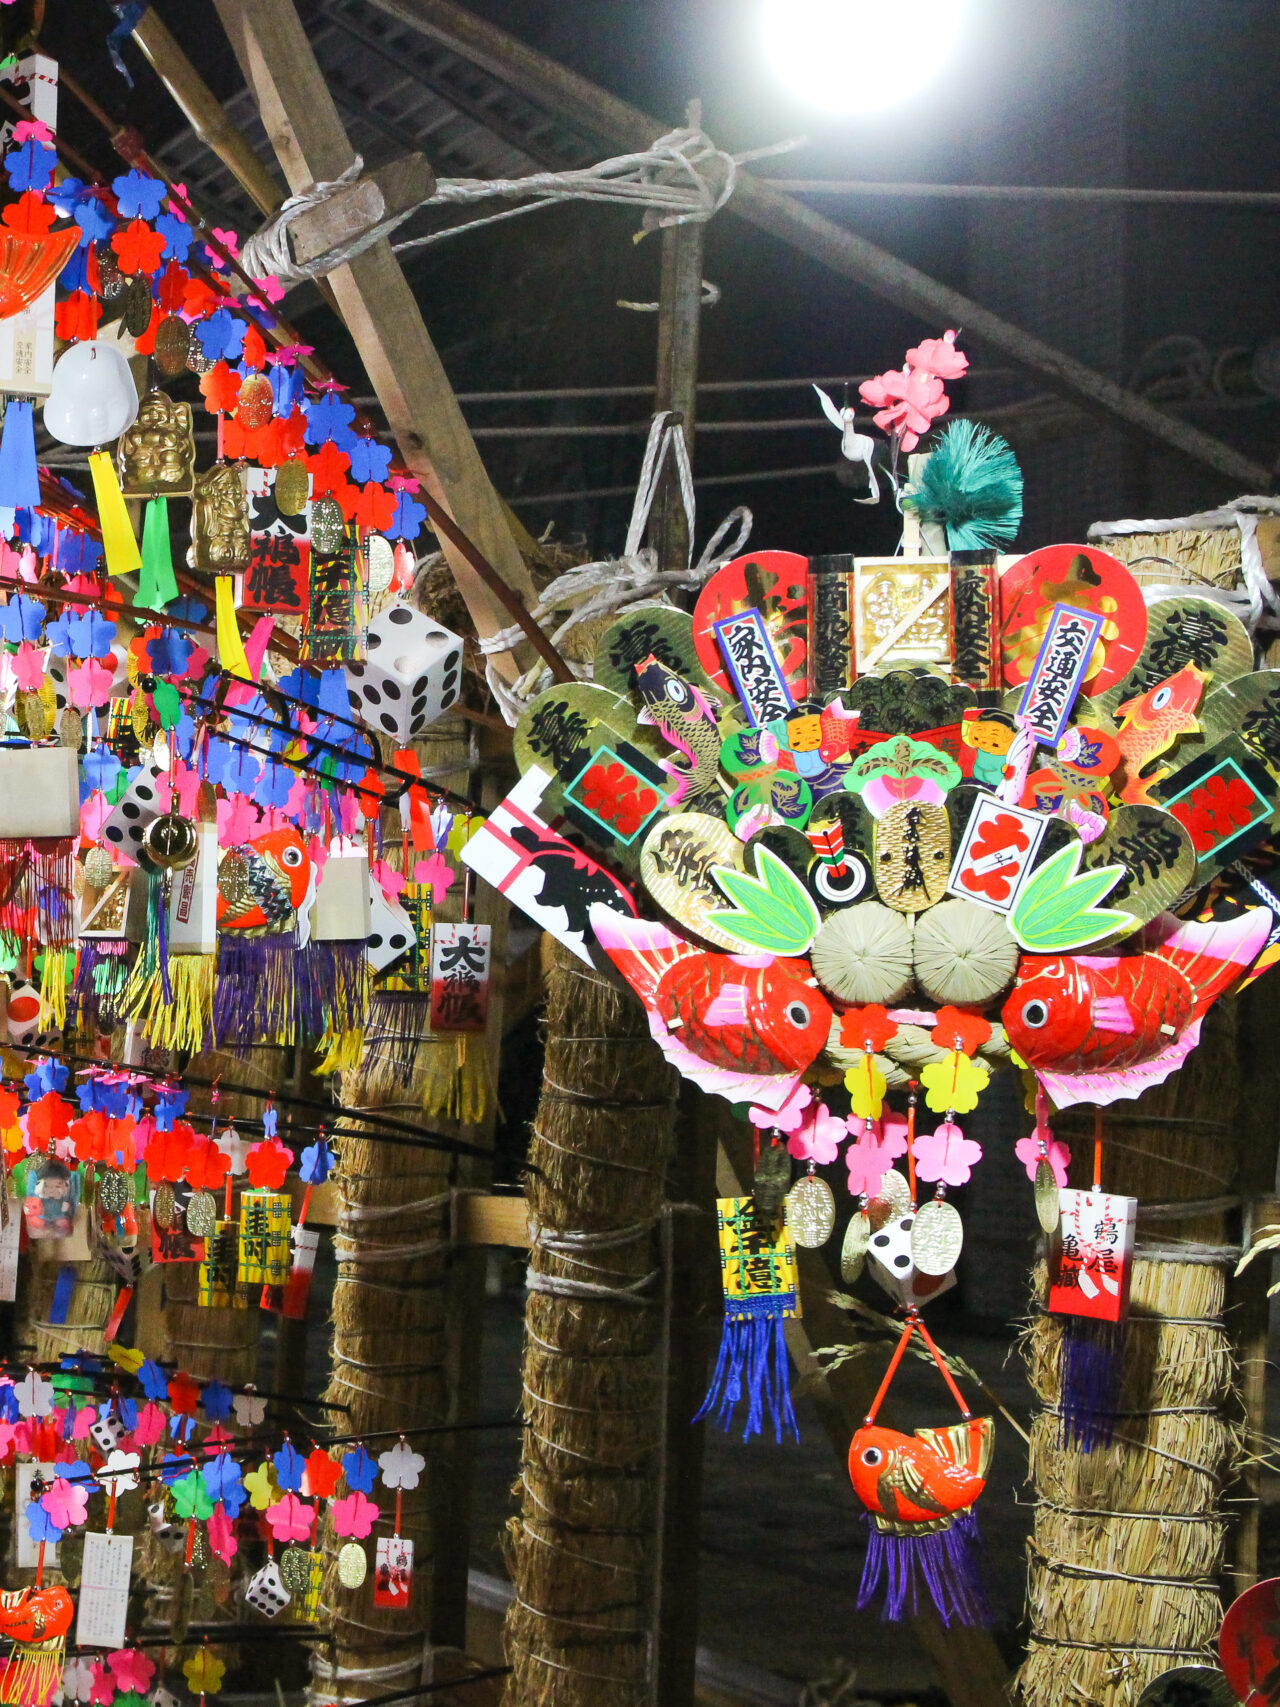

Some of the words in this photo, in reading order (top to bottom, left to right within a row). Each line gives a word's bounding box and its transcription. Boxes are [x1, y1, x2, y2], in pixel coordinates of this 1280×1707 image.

[726, 624, 788, 727] 家内安全
[953, 569, 992, 680] 家内安全
[1029, 621, 1089, 733] 交通安全
[1087, 1220, 1119, 1273] 鶴屋
